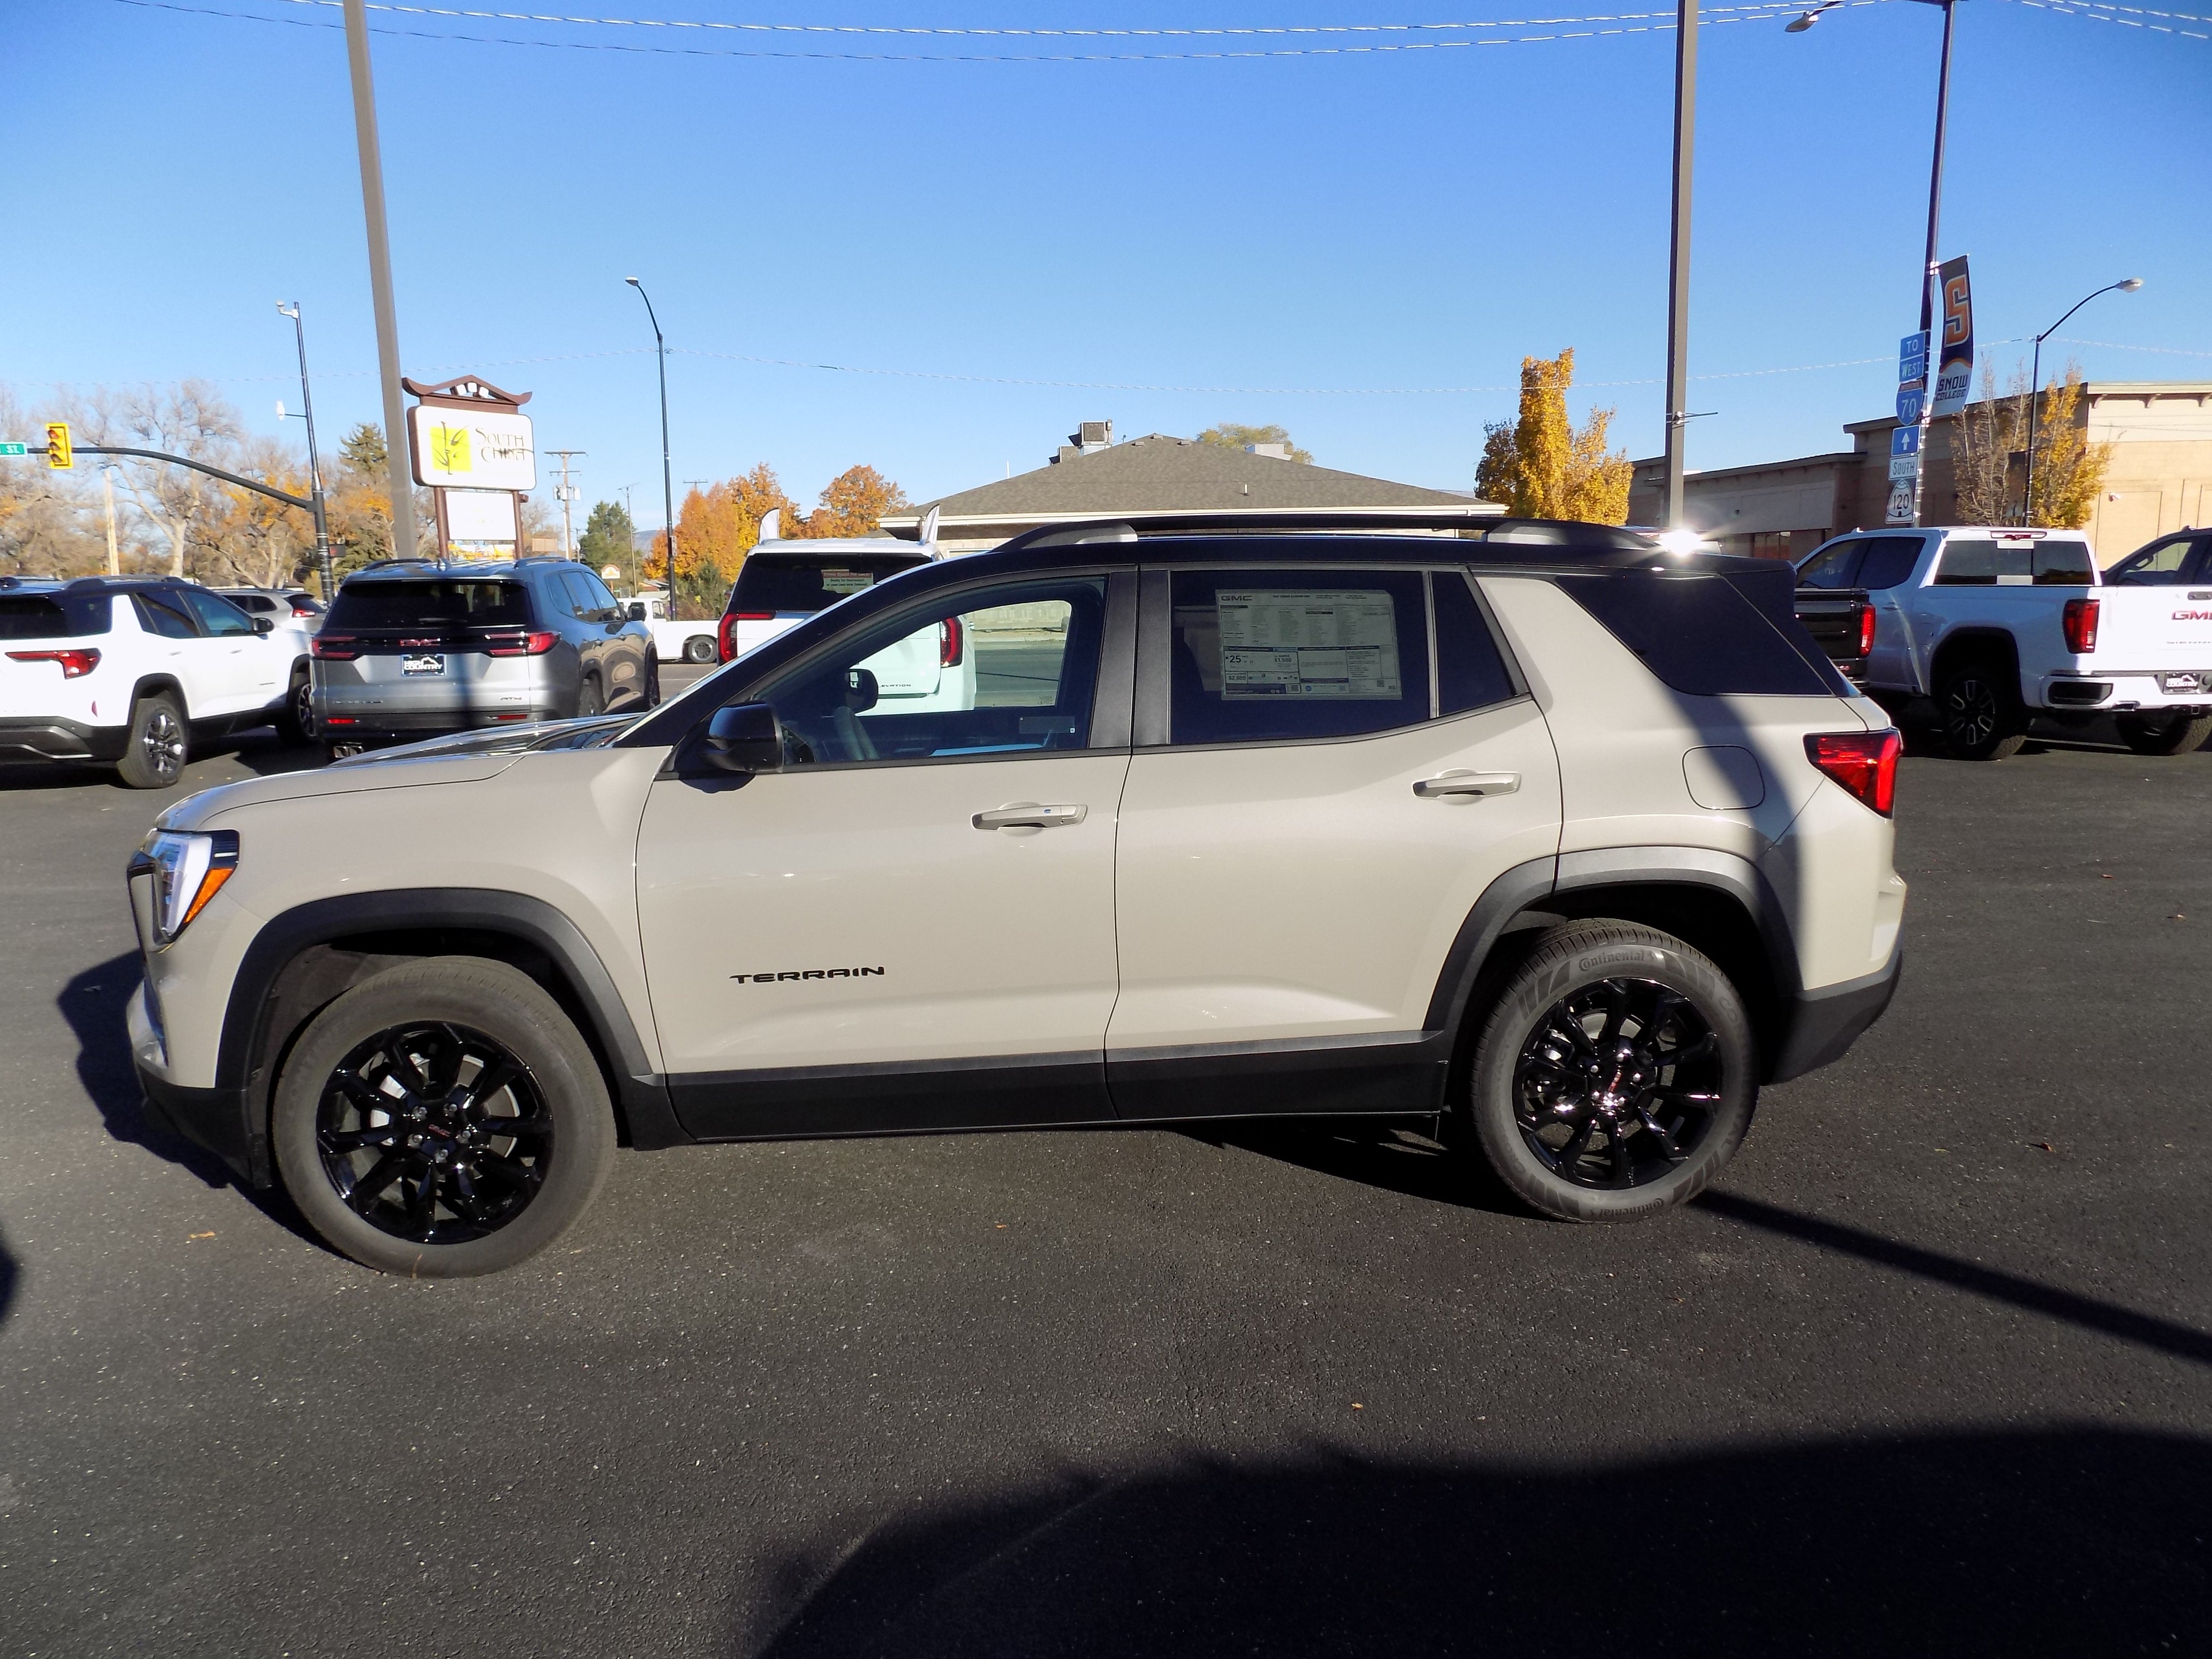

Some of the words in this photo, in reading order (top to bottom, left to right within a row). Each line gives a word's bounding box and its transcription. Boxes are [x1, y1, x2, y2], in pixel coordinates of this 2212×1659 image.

[1907, 339, 1918, 353] TO
[1901, 362, 1921, 377] WEST
[1938, 374, 1968, 391] SNOW
[1936, 389, 1966, 401] COLLEGE
[1902, 398, 1916, 419] 70
[475, 427, 524, 447] SOUTH
[1893, 462, 1914, 475] SOUTH
[1893, 494, 1909, 510] 120
[2171, 611, 2212, 620] GM
[1579, 951, 1644, 972] Continental
[729, 966, 885, 984] TERRAIN
[1599, 1197, 1665, 1216] Continental
